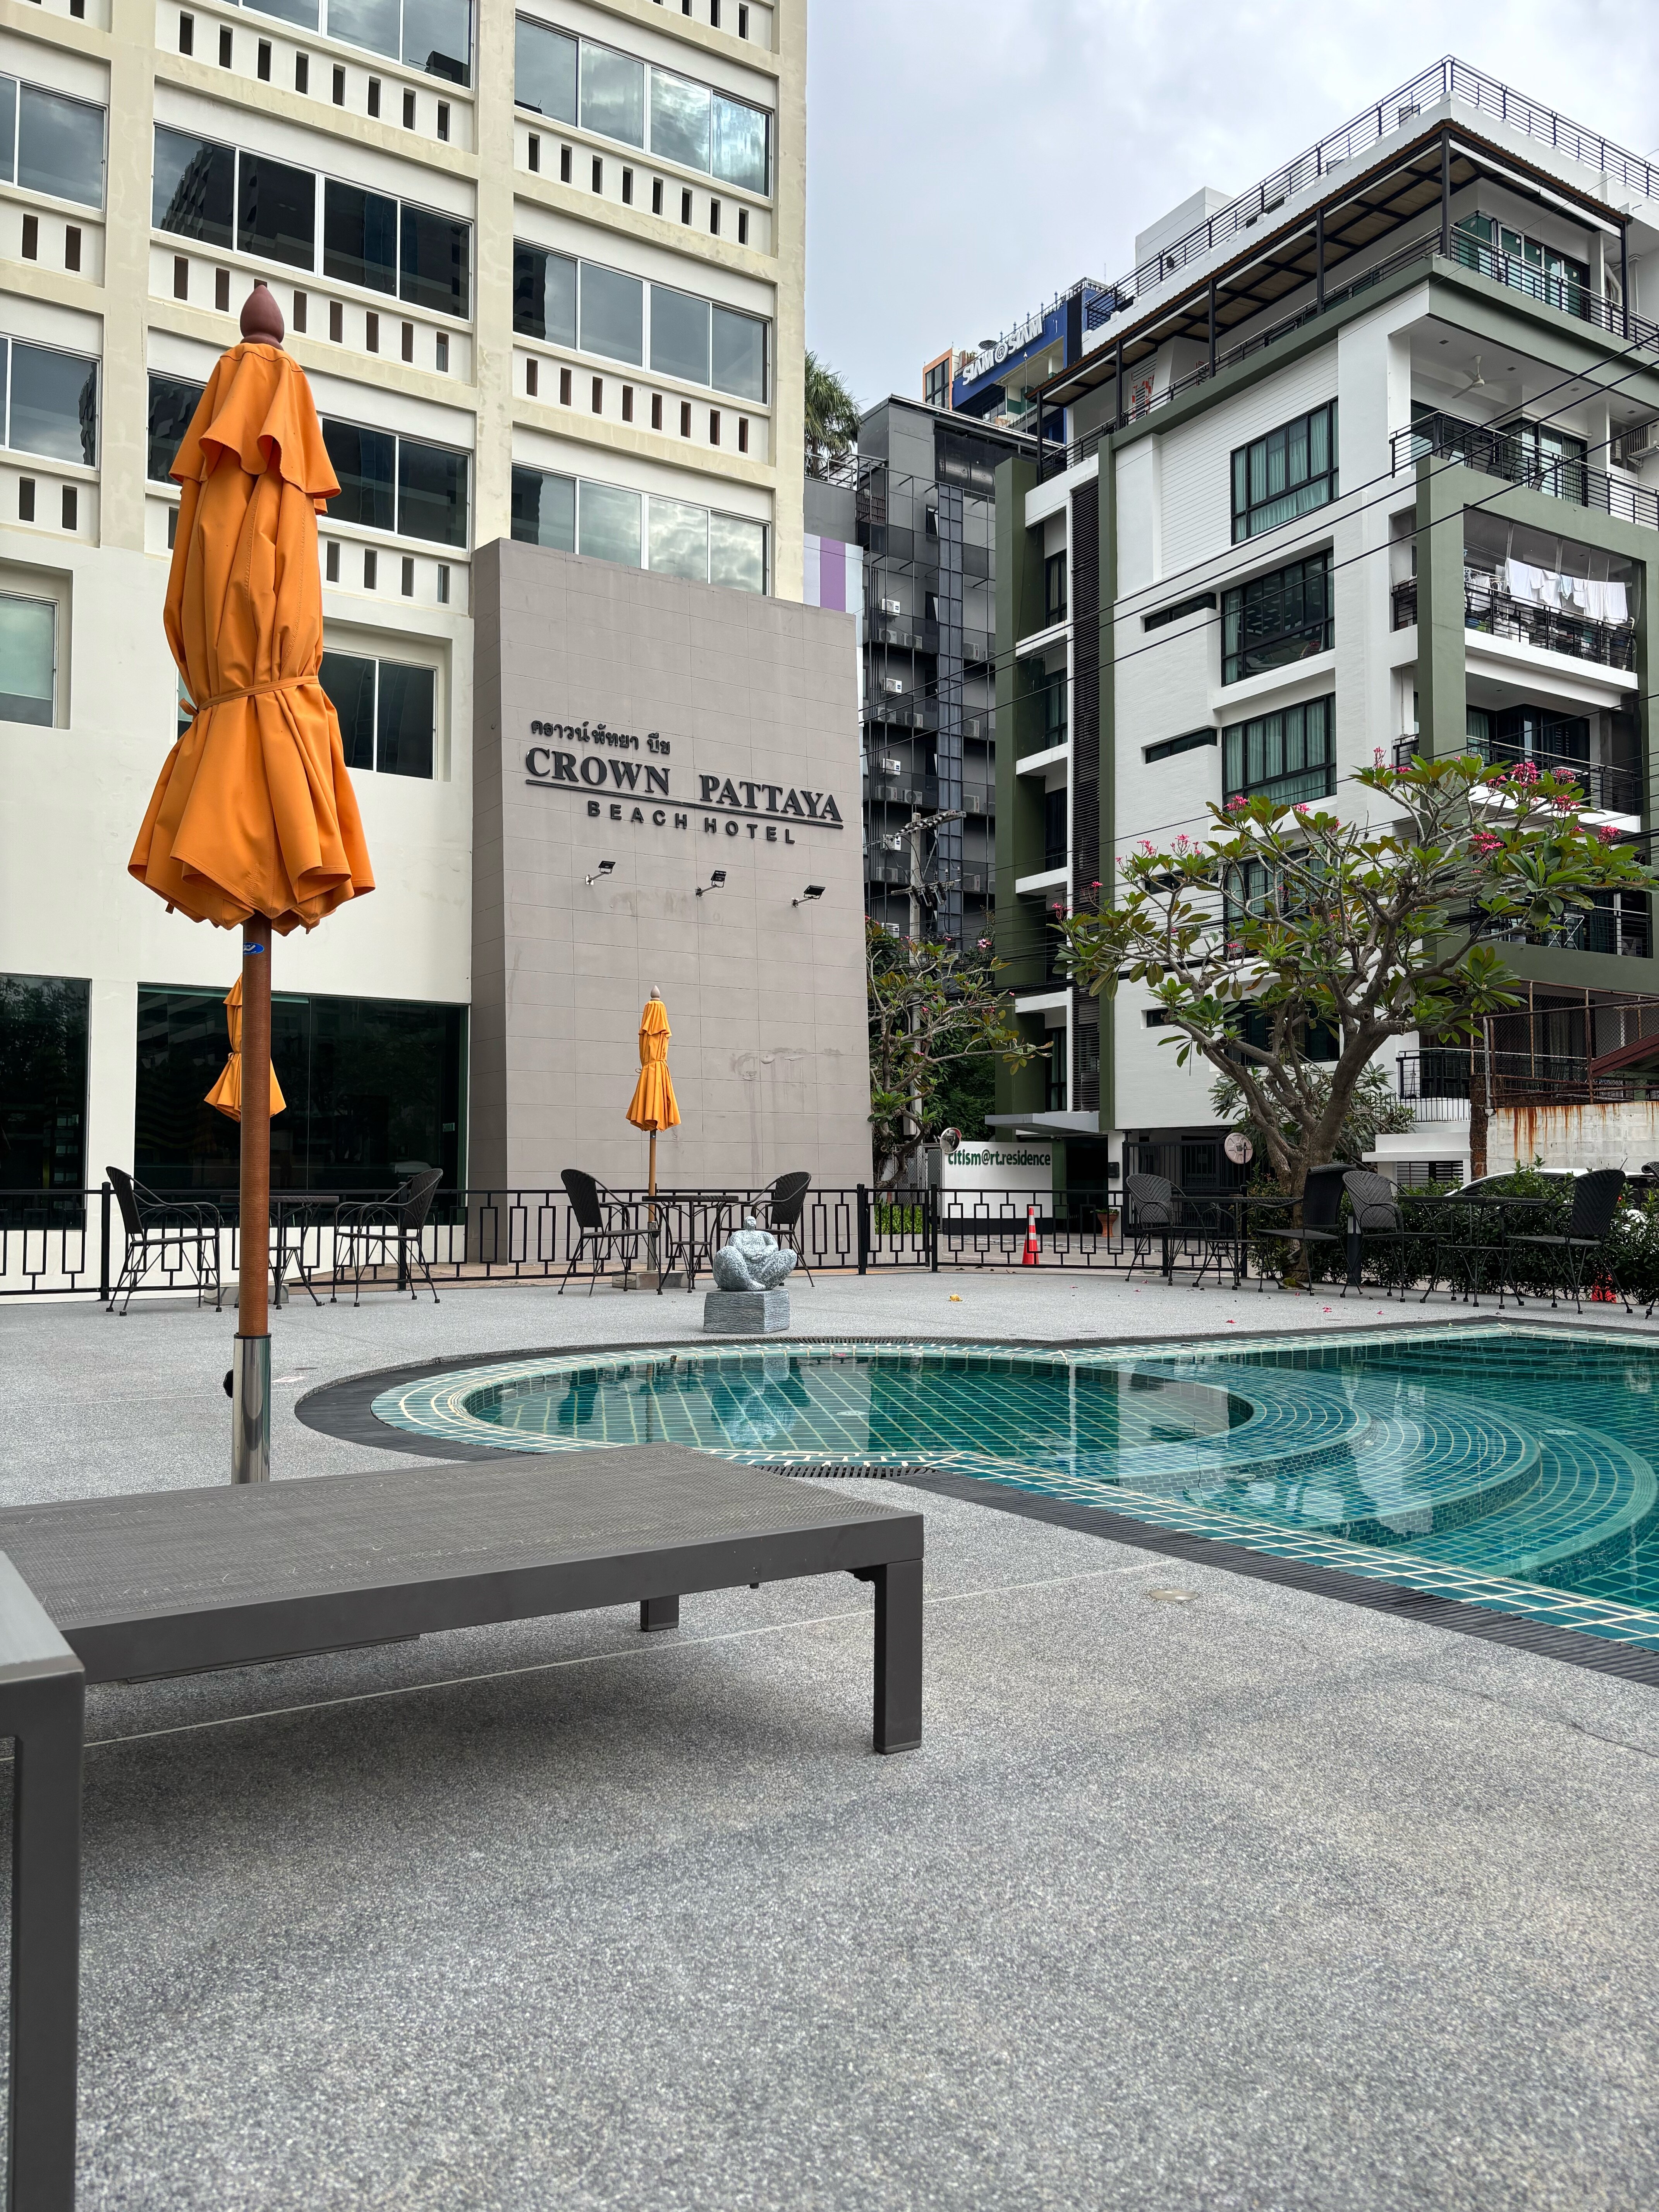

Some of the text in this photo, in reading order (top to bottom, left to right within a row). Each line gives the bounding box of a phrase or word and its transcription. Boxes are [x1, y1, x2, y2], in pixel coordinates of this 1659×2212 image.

[526, 747, 844, 822] CROWN PATTAYA
[587, 800, 795, 845] BEACH HOTEL
